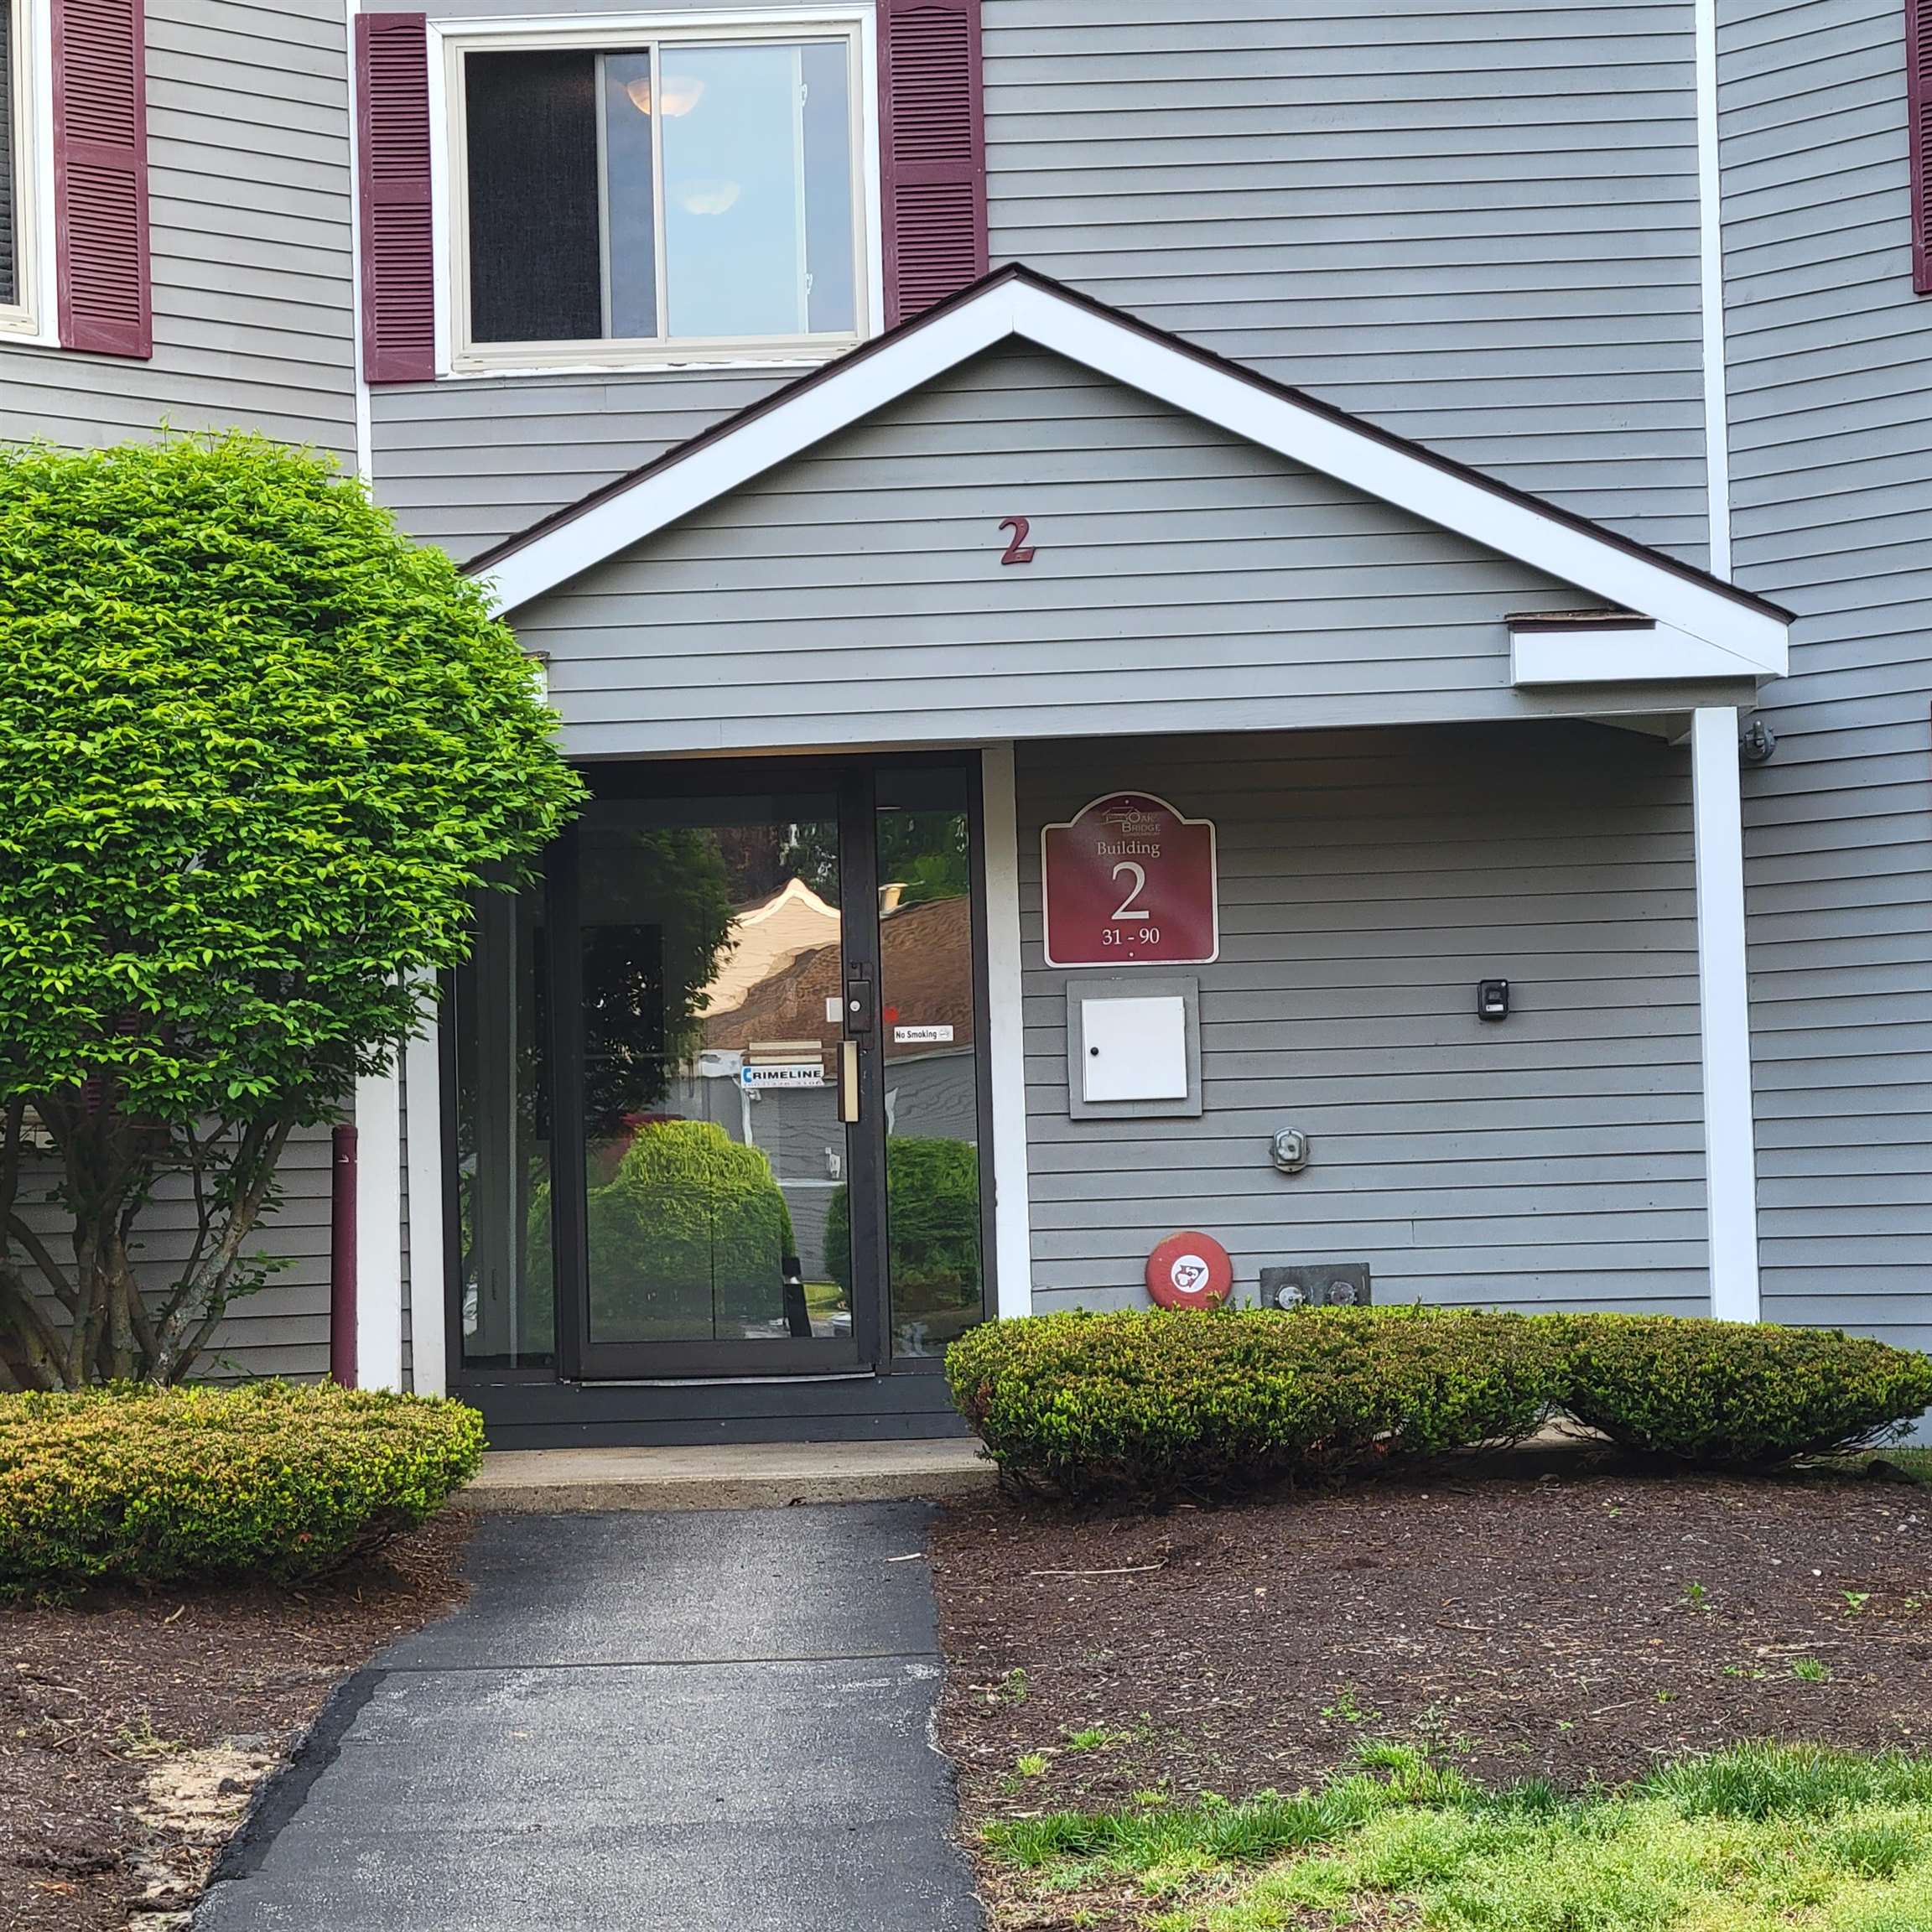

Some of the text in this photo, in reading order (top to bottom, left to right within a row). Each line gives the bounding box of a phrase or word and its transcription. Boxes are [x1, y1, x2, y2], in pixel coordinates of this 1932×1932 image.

[999, 517, 1036, 565] 2
[1097, 840, 1161, 858] Building
[1111, 861, 1150, 920] 2
[1102, 929, 1122, 945] 31
[1139, 927, 1160, 944] 90
[896, 1030, 937, 1040] No Smoking
